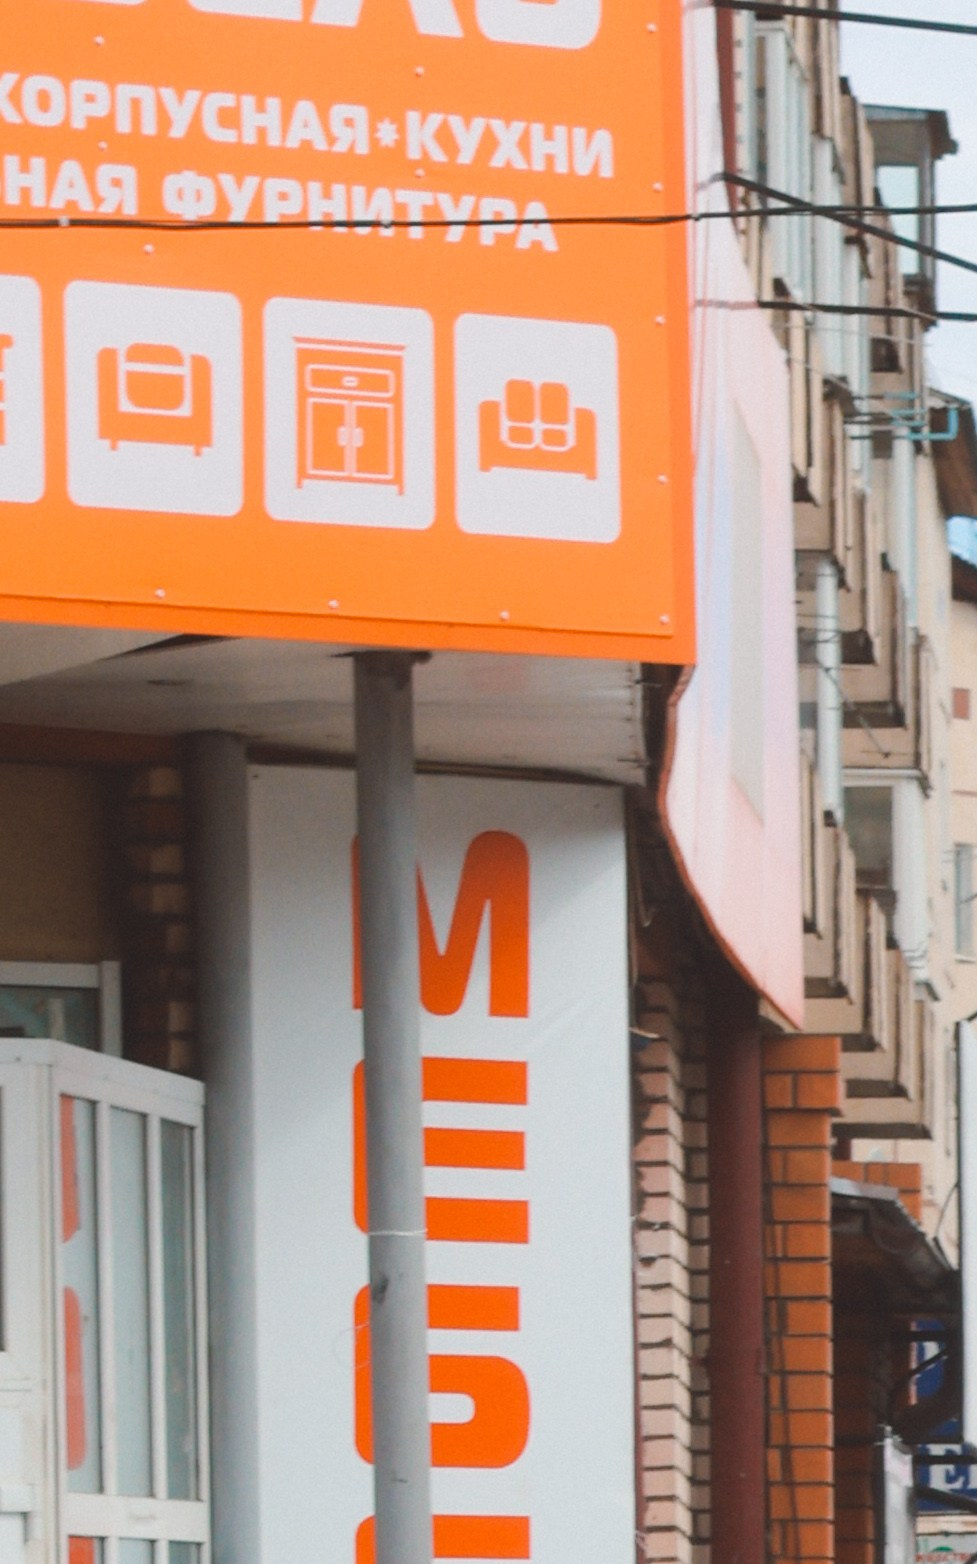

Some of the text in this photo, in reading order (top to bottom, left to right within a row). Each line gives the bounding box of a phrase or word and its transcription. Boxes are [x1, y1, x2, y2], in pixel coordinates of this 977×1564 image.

[405, 110, 614, 178] КУХНИ
[0, 154, 559, 252] НАЯ ФУРНИТУРА
